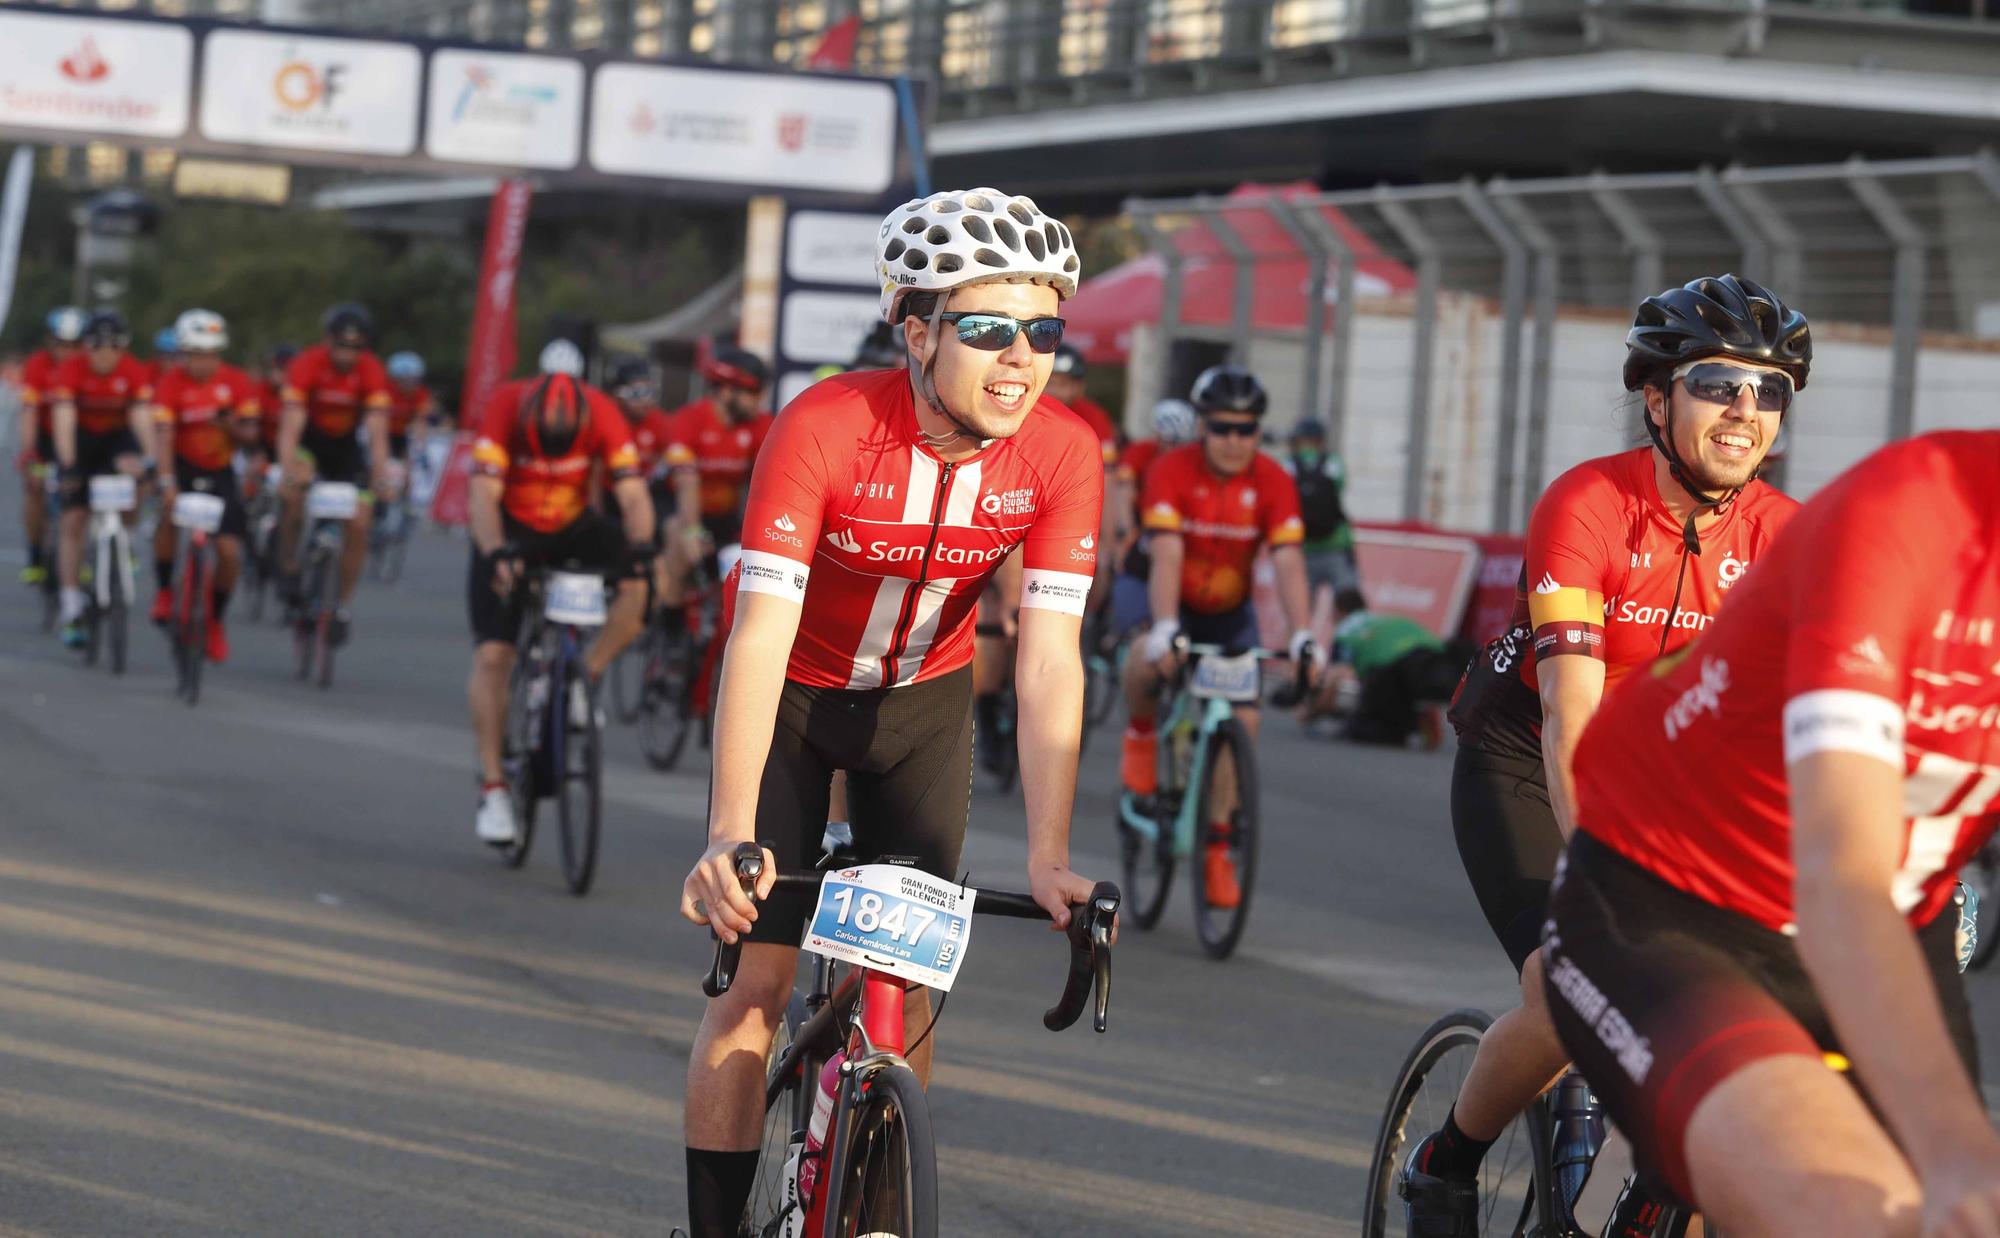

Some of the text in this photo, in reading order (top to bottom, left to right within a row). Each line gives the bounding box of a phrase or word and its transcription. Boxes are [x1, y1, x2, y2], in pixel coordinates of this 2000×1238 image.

[764, 527, 803, 548] Sports
[901, 877, 948, 900] GRAN FONDO
[834, 887, 937, 947] 1847
[822, 940, 859, 957] Santander
[835, 929, 858, 943] Carlos
[895, 946, 912, 959] Lara
[936, 919, 961, 968] 105 km
